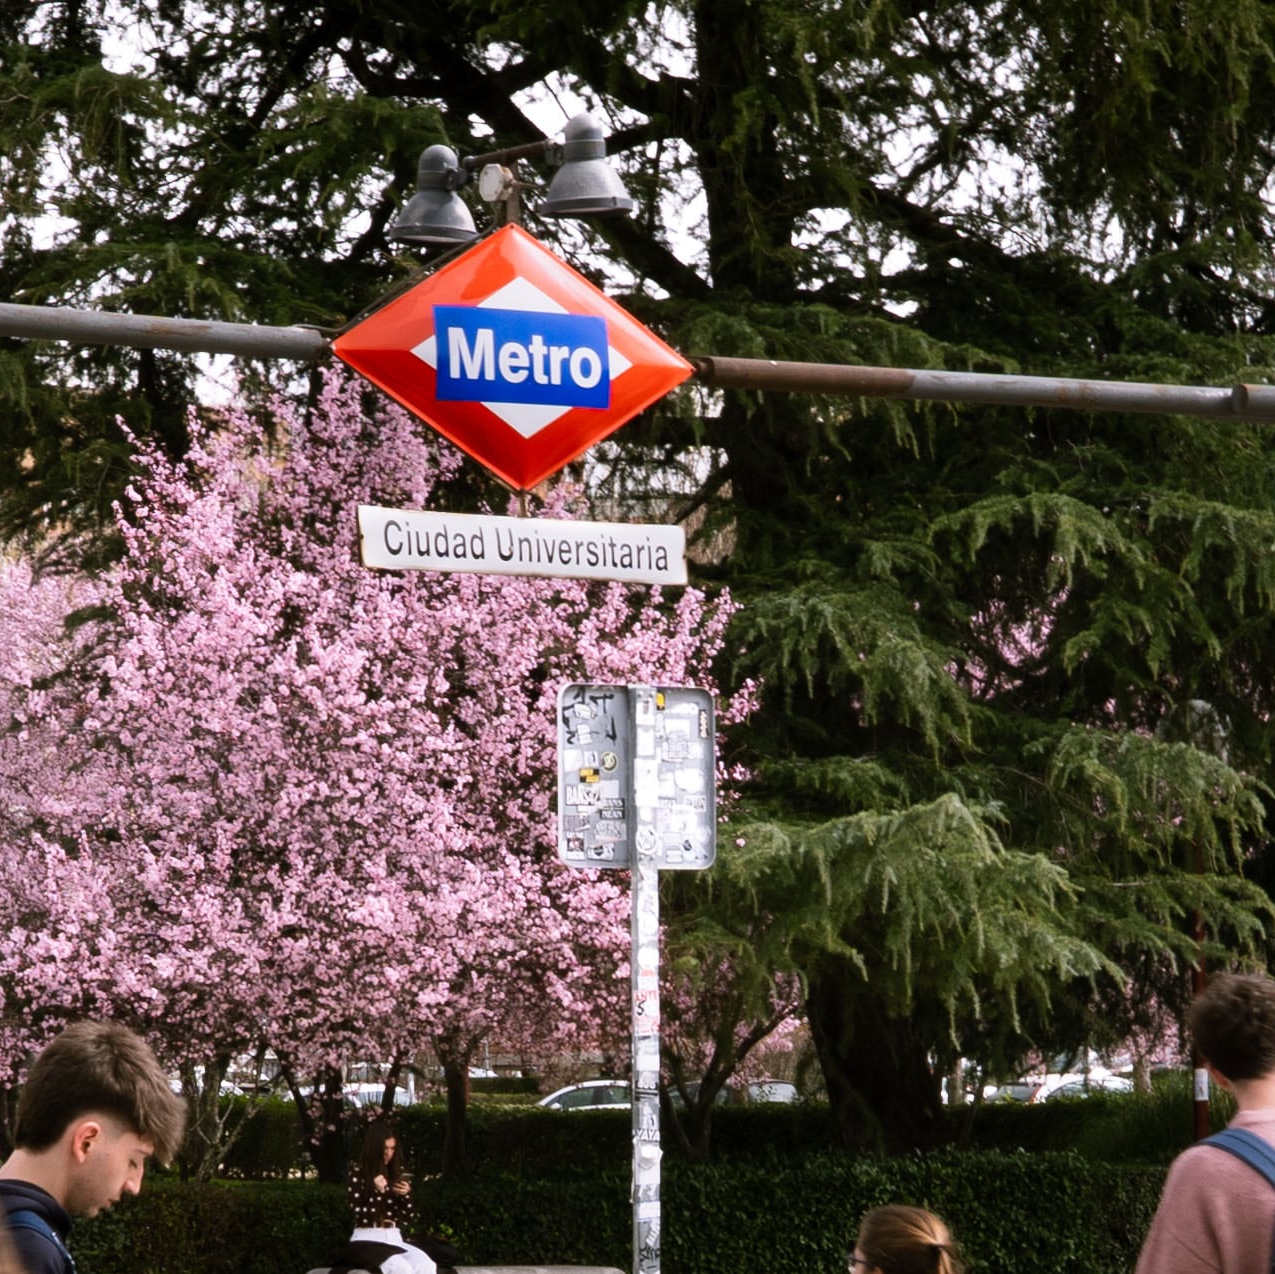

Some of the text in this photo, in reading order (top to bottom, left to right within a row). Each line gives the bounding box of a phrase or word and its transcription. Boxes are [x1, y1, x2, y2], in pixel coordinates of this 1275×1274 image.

[447, 327, 602, 389] Metro
[383, 518, 669, 572] Ciudad Universitaria
